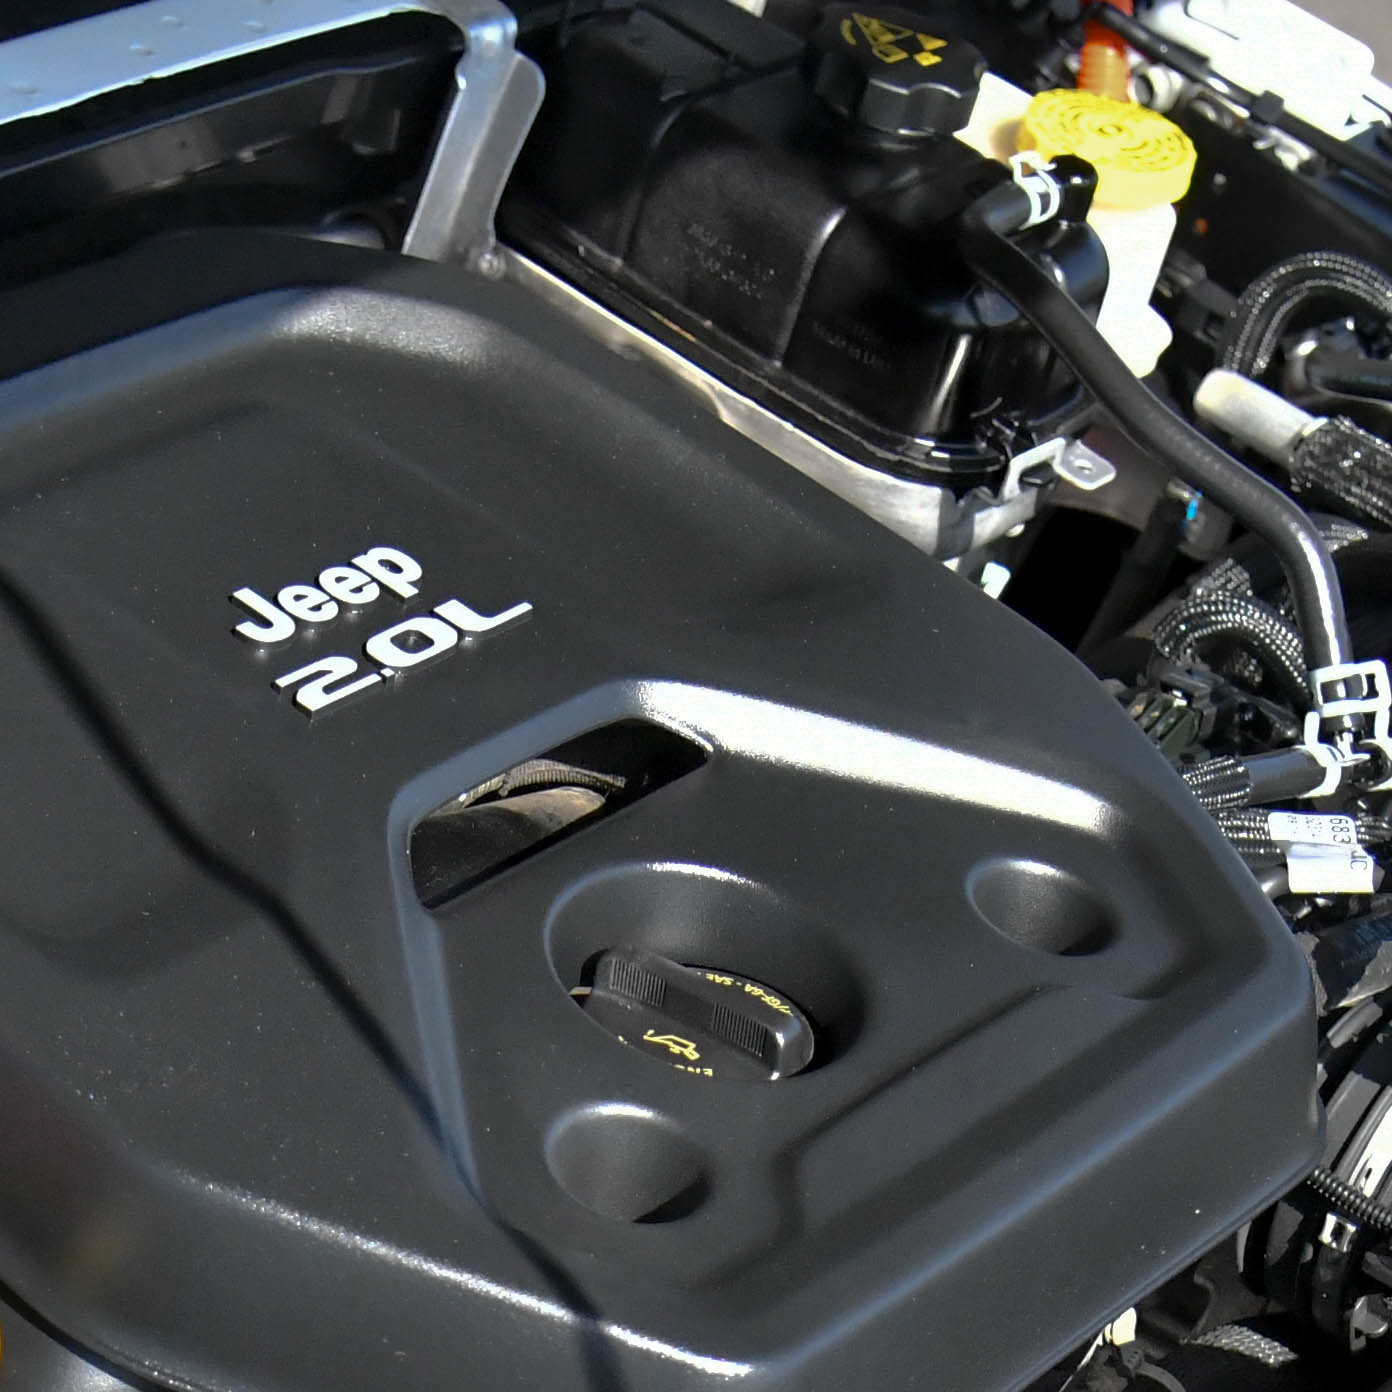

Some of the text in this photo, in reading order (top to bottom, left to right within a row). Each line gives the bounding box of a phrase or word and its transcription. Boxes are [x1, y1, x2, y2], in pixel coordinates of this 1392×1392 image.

[231, 546, 423, 644] Jeep
[274, 598, 534, 713] 2.0L
[705, 973, 735, 986] SAE
